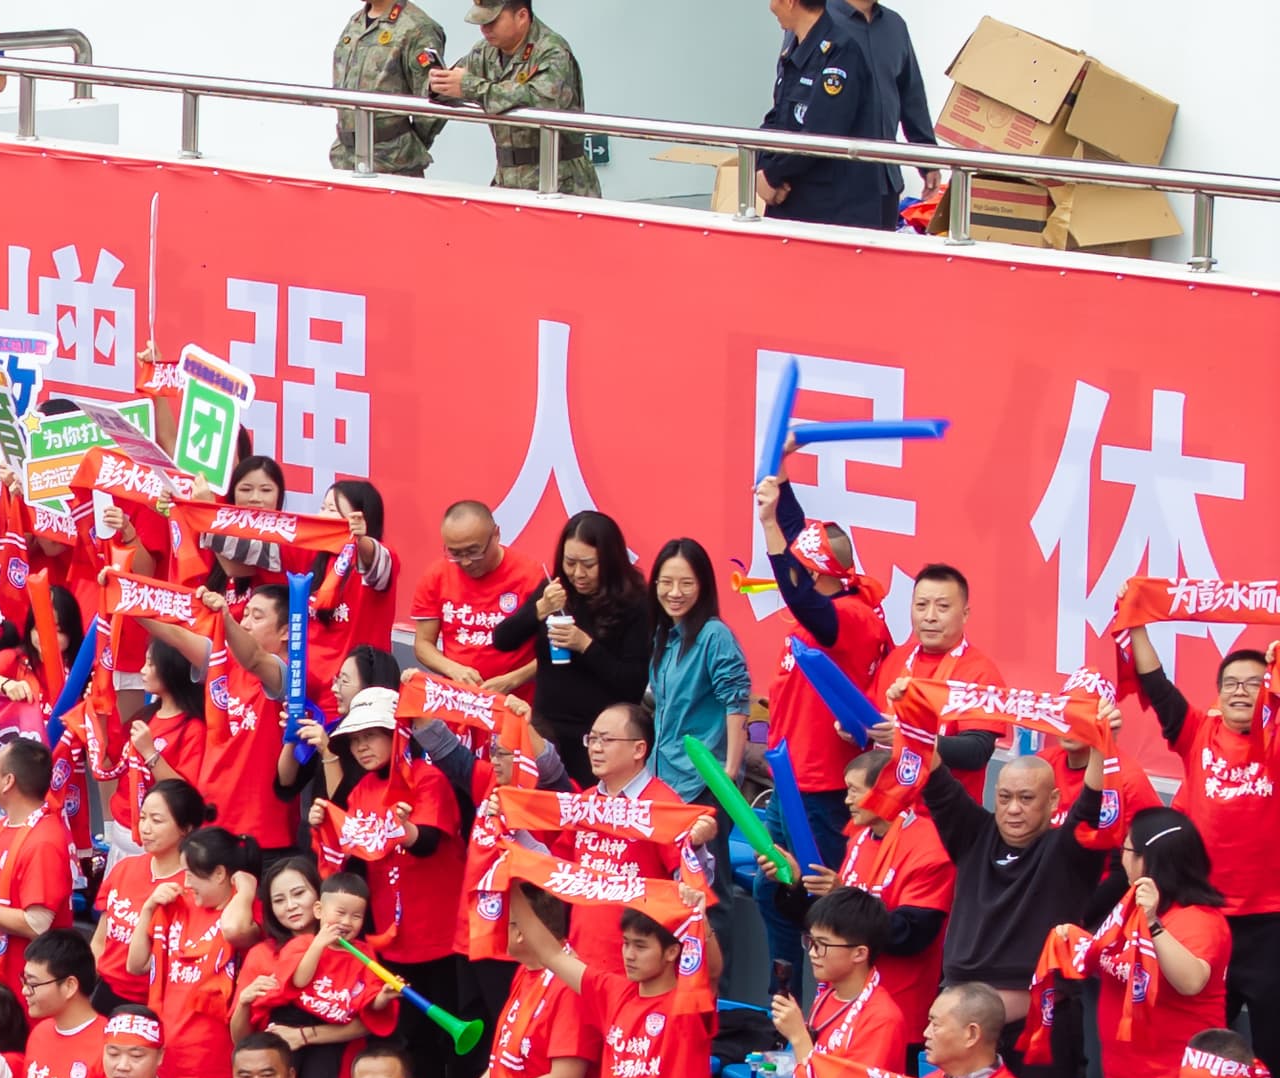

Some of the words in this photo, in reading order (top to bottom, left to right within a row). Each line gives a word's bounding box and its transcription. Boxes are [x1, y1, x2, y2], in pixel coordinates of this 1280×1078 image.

[212, 508, 297, 541] 彭水雄起
[116, 577, 196, 622] 彭水雄起
[1166, 579, 1280, 613] 为彭水而
[422, 678, 496, 728] 彭水雄起
[941, 680, 1072, 732] 彭水雄起
[557, 792, 654, 838] 彭水雄起
[545, 862, 648, 903] 为彭水而战
